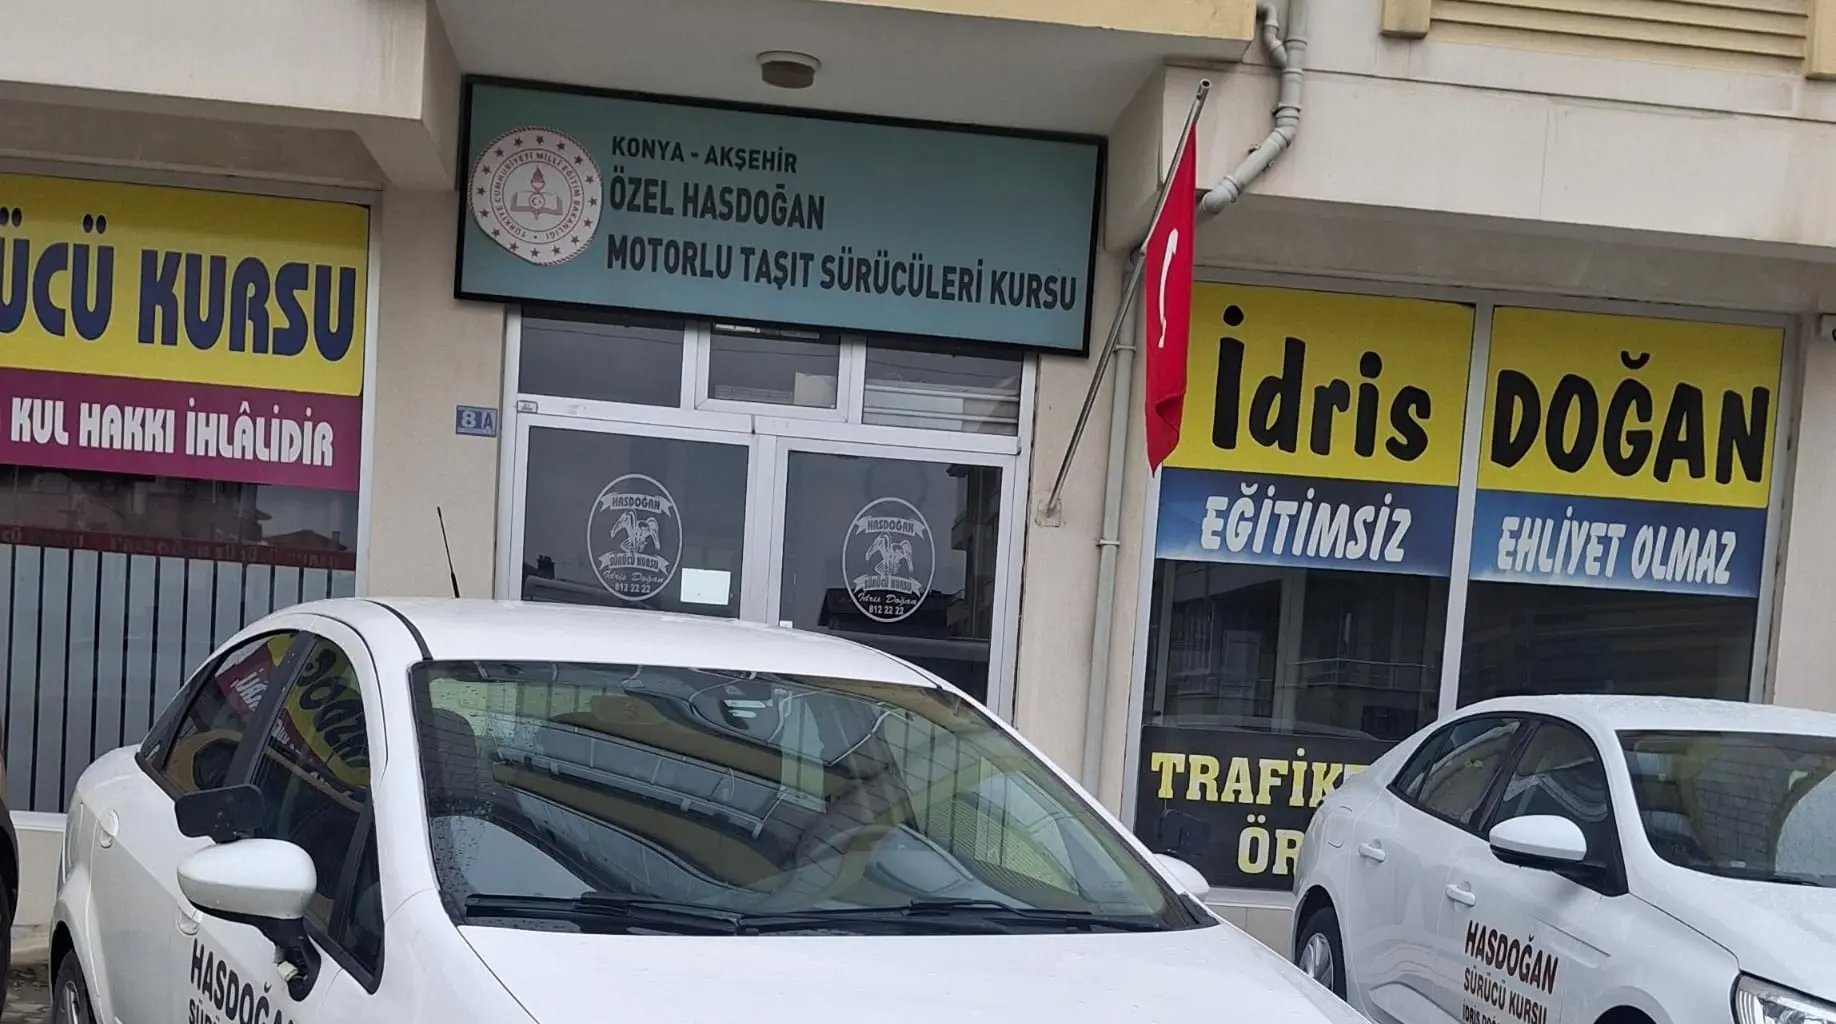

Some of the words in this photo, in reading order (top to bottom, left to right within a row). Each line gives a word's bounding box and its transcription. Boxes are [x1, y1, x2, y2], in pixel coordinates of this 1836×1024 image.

[612, 136, 685, 162] KONYA
[704, 145, 798, 174] AKŞEHİR
[609, 165, 674, 215] ÖZEL
[682, 183, 825, 230] HASDOĞAN
[138, 248, 356, 361] KURSU
[607, 234, 733, 280] MOTORLU
[740, 246, 814, 290] TAŞIT
[820, 246, 984, 303] SÜRÜCÜLERİ
[989, 269, 1077, 311] KURSU
[460, 410, 477, 429] 8
[482, 411, 495, 431] A
[1211, 304, 1432, 462] İdris
[1490, 350, 1770, 484] DOĞAN
[11, 397, 69, 446] KUL
[79, 402, 175, 453] HAKKI
[185, 397, 334, 466] İHLÂLİDİR
[1201, 482, 1412, 562] EĞİTİMSİZ
[1497, 505, 1627, 578] EHLİYET
[1631, 524, 1737, 585] OLMAZ
[614, 582, 628, 592] 812
[630, 583, 640, 593] 22
[641, 583, 652, 593] 22
[868, 604, 882, 614] 812
[884, 605, 894, 615] 22
[895, 606, 905, 616] 22
[1151, 747, 1371, 808] TRAFİK
[1463, 965, 1506, 1011] SÜRÜCÜ
[1464, 919, 1559, 995] HASDOĞAN
